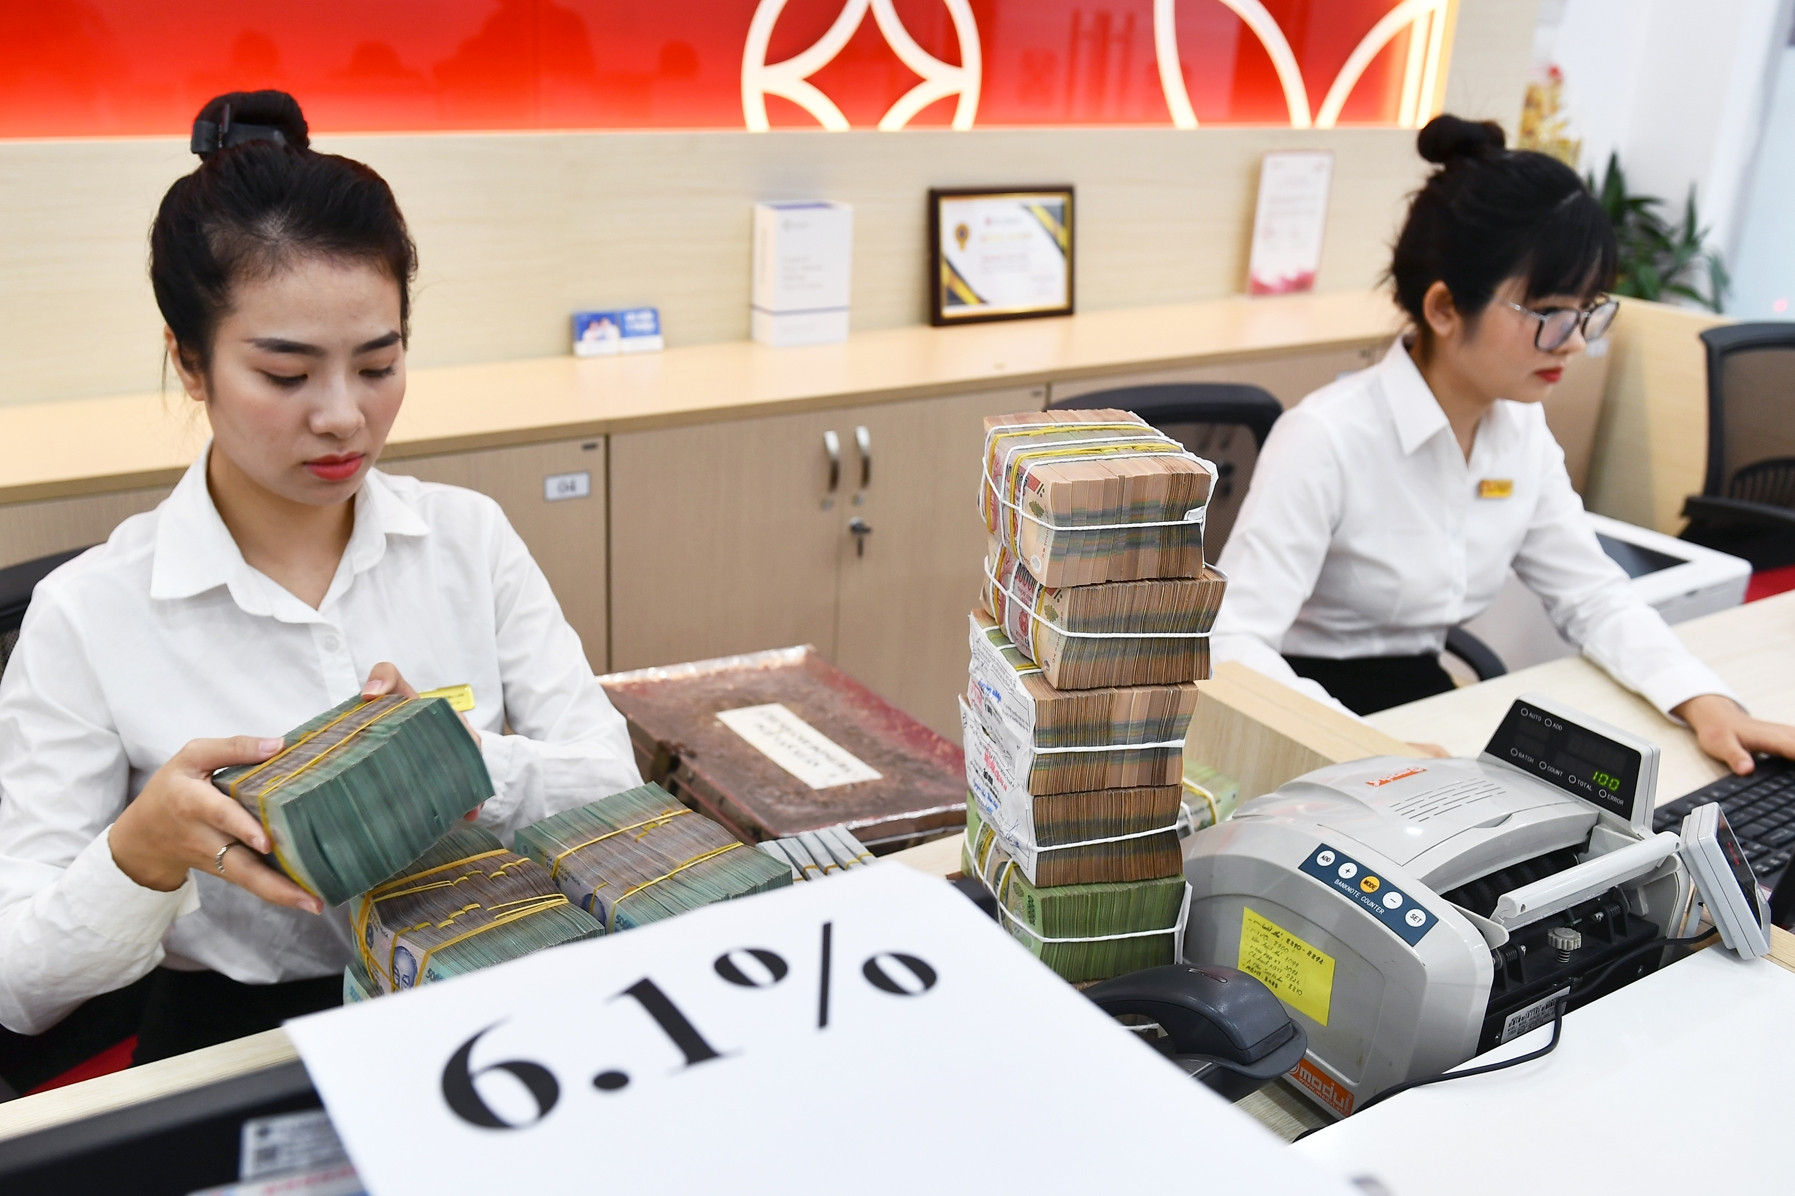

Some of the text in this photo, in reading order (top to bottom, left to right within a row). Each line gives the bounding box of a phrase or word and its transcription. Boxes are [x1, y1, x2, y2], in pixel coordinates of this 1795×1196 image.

[1529, 712, 1563, 731] AUTO ADD
[1518, 752, 1625, 806] BATCH COUNT TOTAL ERROR
[1592, 770, 1621, 791] 100
[1320, 854, 1332, 863] ADD
[1363, 879, 1378, 891] MODE
[1334, 878, 1385, 915] BANKNOTE COUNTER
[1409, 913, 1422, 924] SET
[440, 920, 939, 1131] 6.1%
[1300, 1066, 1350, 1113] modul
